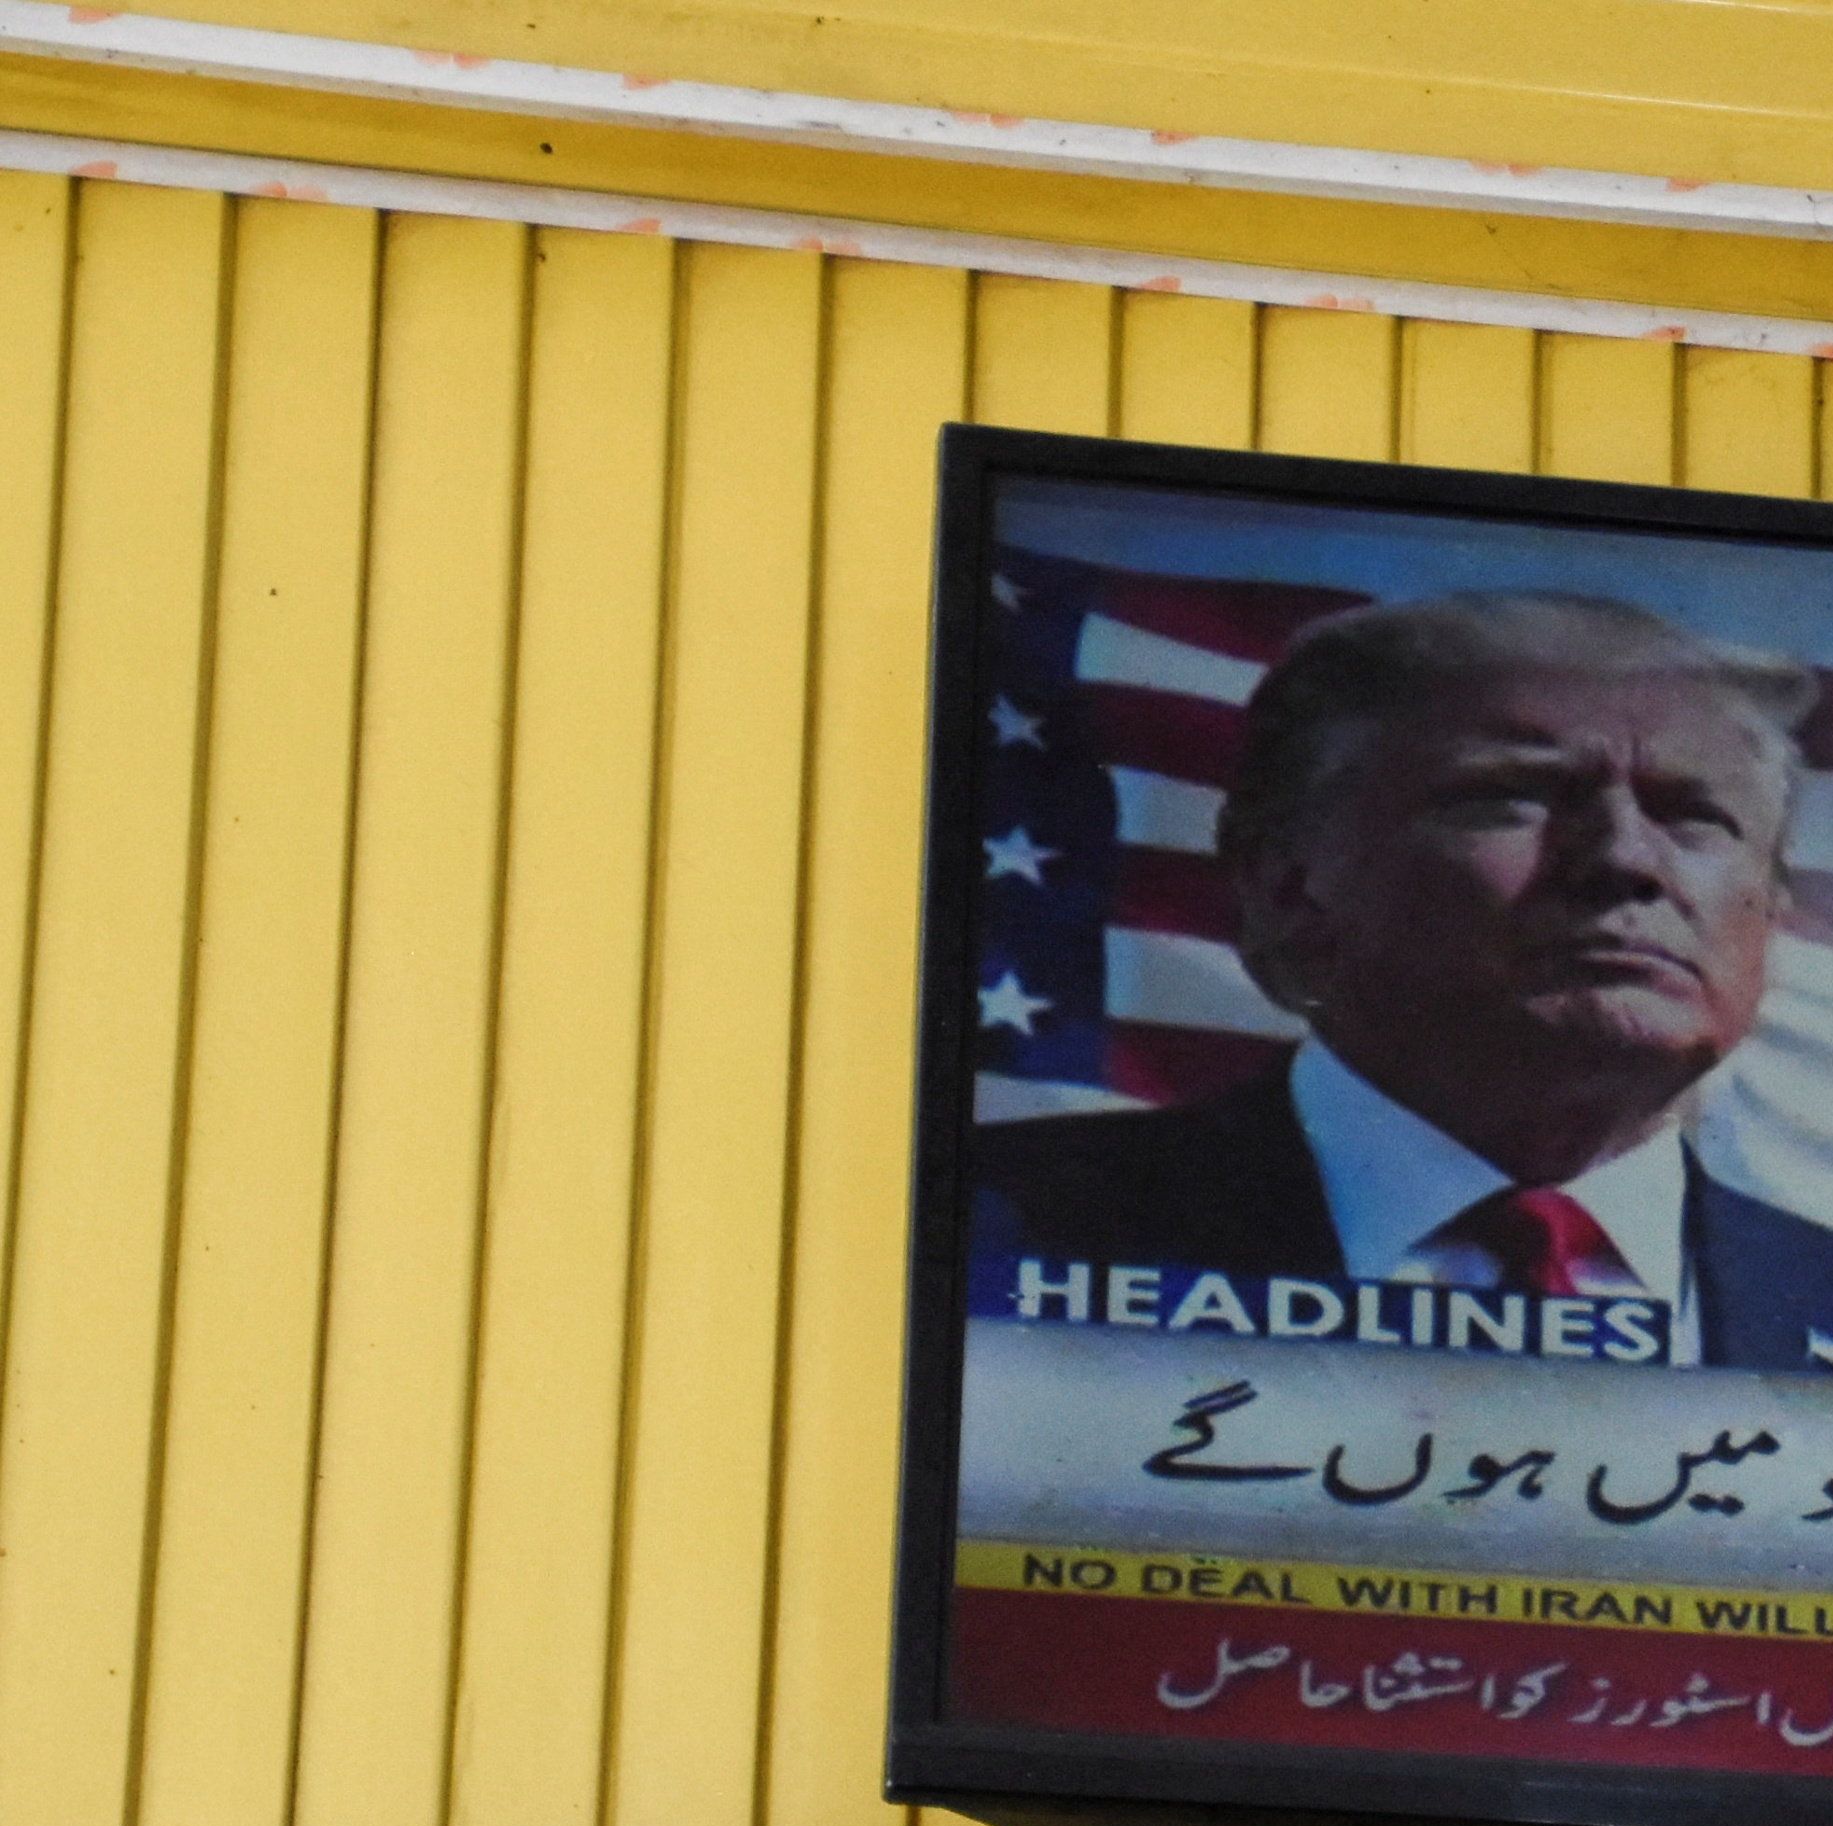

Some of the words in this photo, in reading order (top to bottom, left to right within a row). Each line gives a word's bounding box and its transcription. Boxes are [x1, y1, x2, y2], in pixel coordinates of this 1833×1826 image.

[1014, 1258, 1671, 1364] HEADLINES
[1143, 1379, 1316, 1482] گے
[1322, 1433, 1557, 1505] ہوں
[1586, 1427, 1781, 1526] میں
[1022, 1551, 1117, 1593] NO
[1141, 1563, 1313, 1605] DEAL
[1336, 1575, 1500, 1617] WITH
[1522, 1587, 1674, 1627] IRAN
[1156, 1637, 1354, 1710] حاصل
